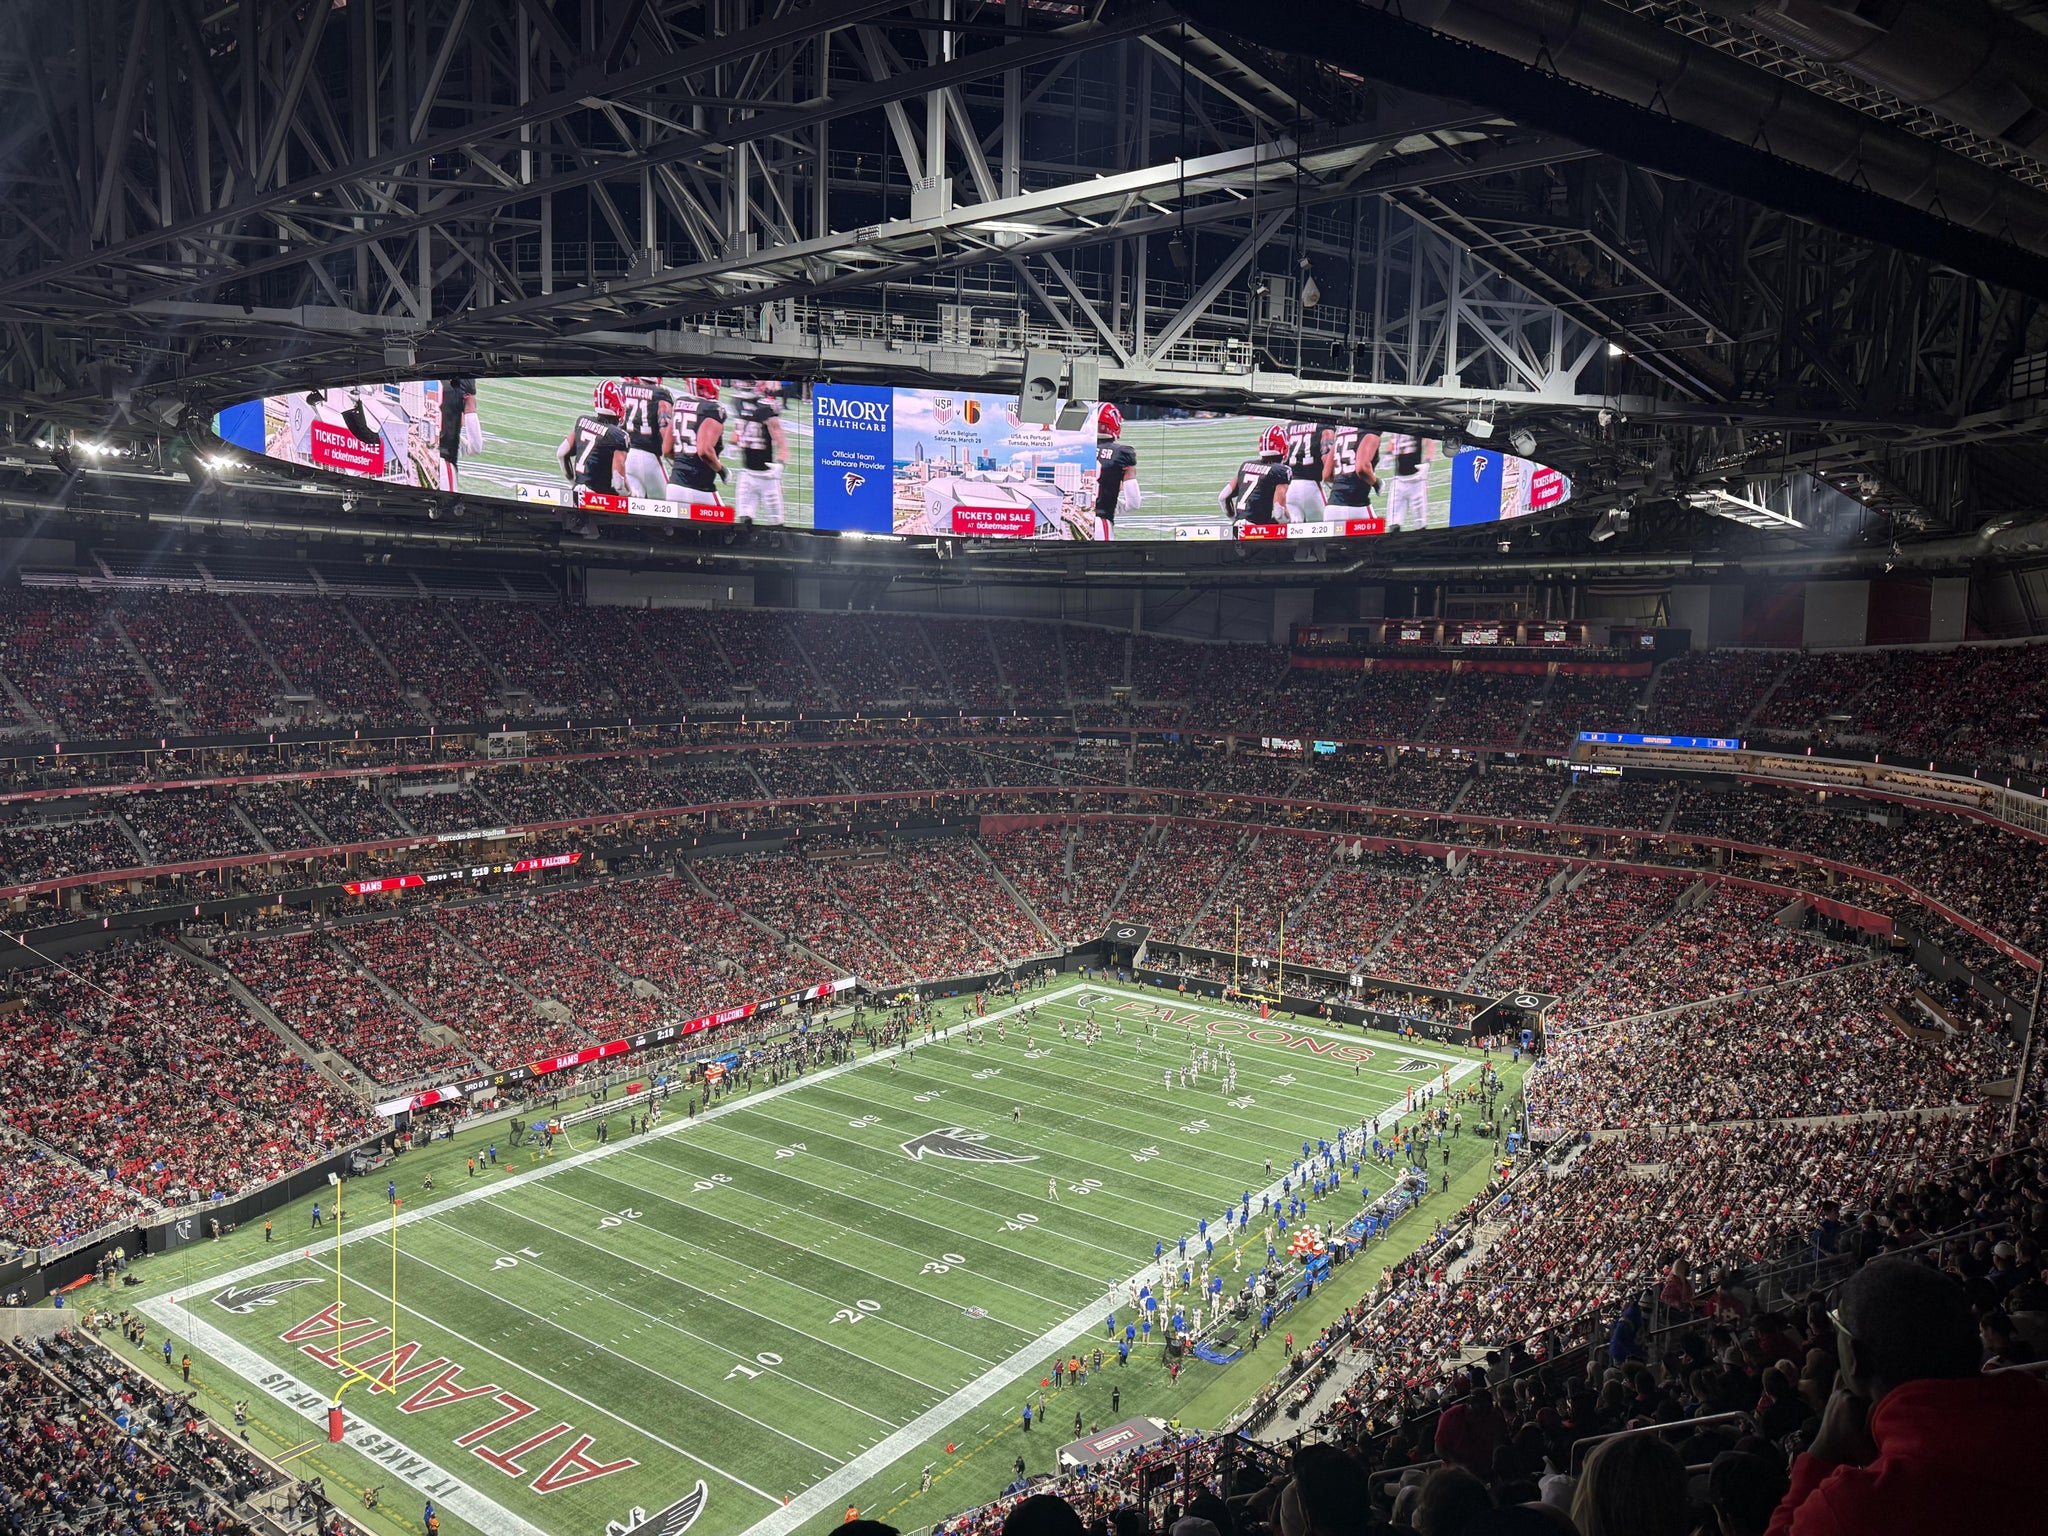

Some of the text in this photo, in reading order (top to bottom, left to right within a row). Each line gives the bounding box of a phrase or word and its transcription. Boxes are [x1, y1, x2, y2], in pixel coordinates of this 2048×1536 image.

[817, 396, 890, 422] EMORY
[935, 398, 952, 410] USA
[1008, 402, 1019, 413] US
[626, 398, 652, 435] 71
[818, 418, 886, 432] HEALTHCARE
[315, 428, 345, 448] TICKETS
[347, 438, 359, 450] ON
[1030, 434, 1051, 442] Portugal
[576, 430, 597, 474] 7
[832, 450, 875, 461] Official Team
[1101, 448, 1114, 460] SR
[1289, 434, 1314, 466] 71
[324, 448, 372, 466] AT ticketmaster
[822, 458, 886, 471] Healthcare Provider
[538, 489, 550, 498] LA
[563, 492, 569, 503] 0
[1236, 474, 1260, 510] 7
[590, 496, 610, 506] ATL
[617, 499, 627, 510] 14
[631, 502, 672, 514] 2ND 2:20
[699, 508, 714, 517] 3RD
[720, 510, 725, 518] 9
[957, 511, 1031, 522] TICKETS ON SALE
[976, 522, 1021, 531] ticketmaster
[1197, 528, 1210, 536] LA
[1223, 528, 1229, 537] 0
[1250, 526, 1270, 536] ATL
[1276, 527, 1286, 536] 14
[1290, 526, 1328, 535] 2ND 2:20
[1354, 523, 1366, 531] 3RD
[438, 832, 481, 843] Mercedes-Benz
[482, 829, 506, 838] Stadium
[530, 861, 538, 869] 14
[542, 856, 571, 867] FALCONS
[472, 866, 490, 877] 2:19
[360, 881, 383, 893] RAMS
[400, 878, 406, 887] 0
[702, 1018, 710, 1028] 14
[715, 1008, 744, 1025] FALCONS
[1198, 1006, 1324, 1035] INSPIRE CHANGE
[657, 1027, 674, 1041] 2:19
[1112, 1001, 1376, 1062] FALCONS
[600, 1047, 606, 1056] 0
[556, 1054, 579, 1069] RAMS
[518, 1070, 524, 1078] 2
[972, 1067, 1001, 1080] 30
[494, 1076, 504, 1085] 33
[1270, 1074, 1296, 1087] 10
[465, 1083, 478, 1092] 3RD
[913, 1090, 943, 1103] 40
[1227, 1096, 1255, 1110] 20
[848, 1114, 882, 1128] 50
[1180, 1120, 1208, 1135] 30
[776, 1142, 808, 1159] 40
[1130, 1146, 1160, 1164] 40
[694, 1172, 734, 1191] 30
[1068, 1178, 1104, 1196] 50
[601, 1207, 644, 1228] 20
[1006, 1213, 1039, 1233] 40
[497, 1246, 544, 1268] 10
[926, 1253, 966, 1276] 30
[834, 1298, 882, 1325] 20
[731, 1351, 783, 1380] 10
[259, 1373, 296, 1394] US
[279, 1302, 640, 1494] ATLANTA
[286, 1392, 324, 1410] OF
[1093, 1430, 1135, 1451] ESPN
[356, 1433, 432, 1481] TAKES
[424, 1478, 461, 1499] IT
